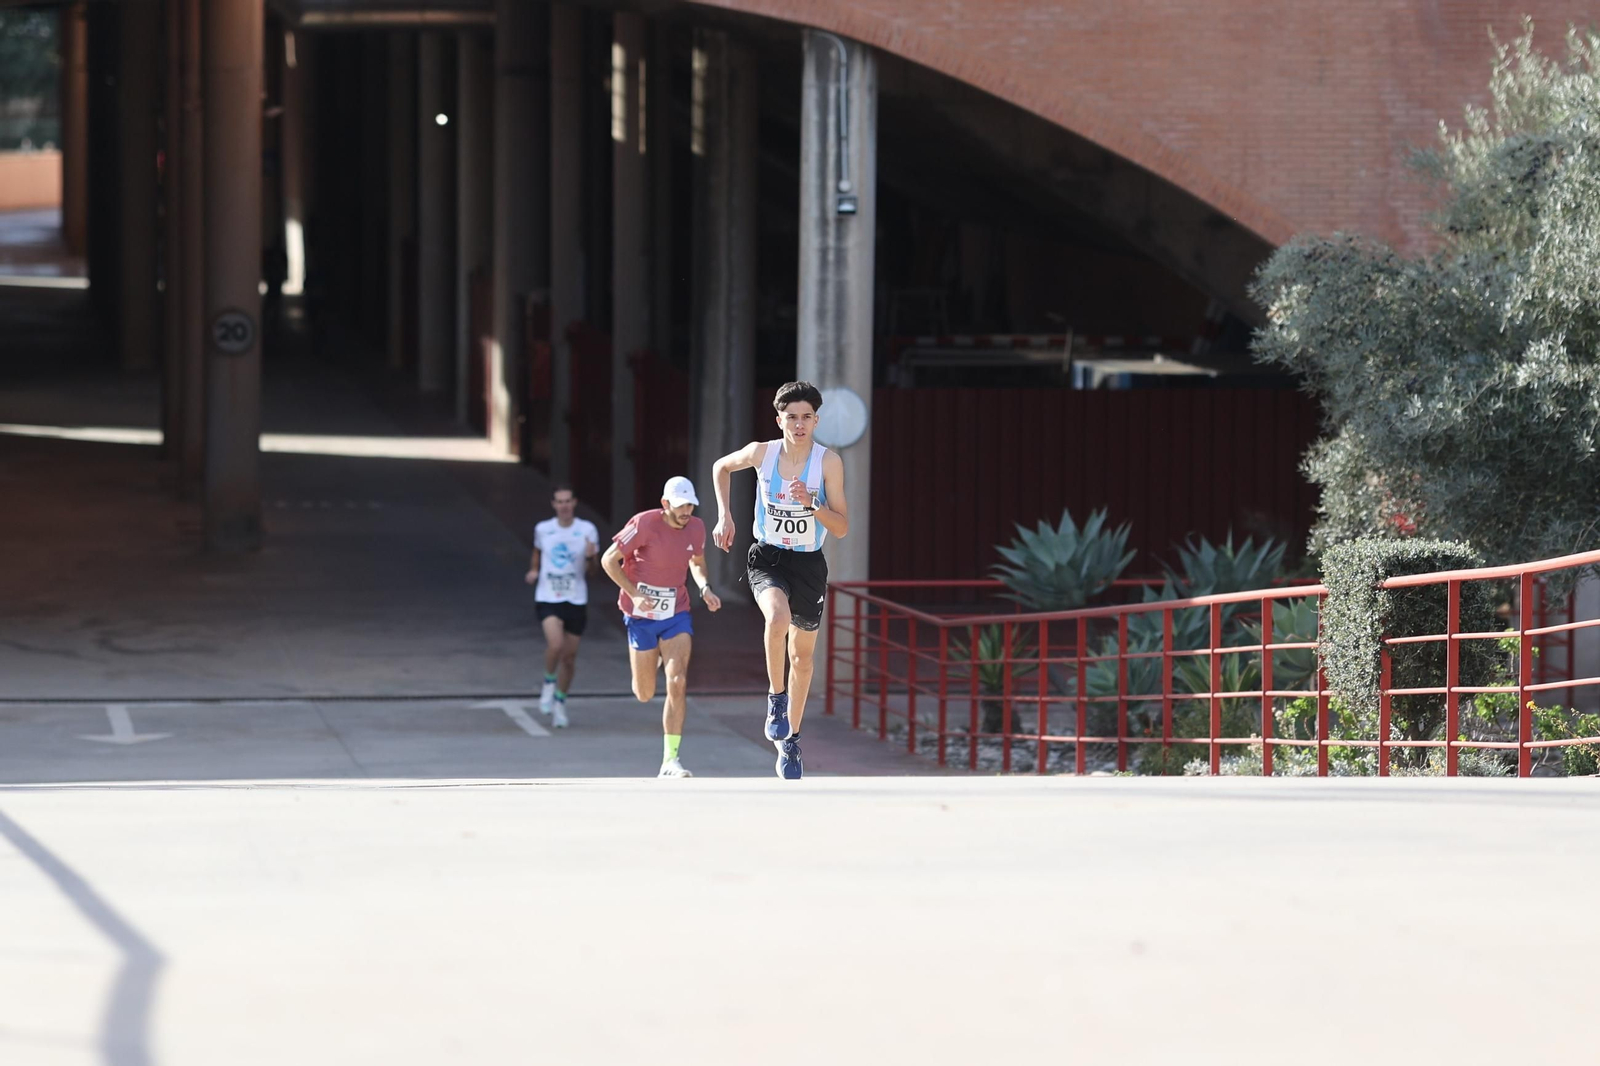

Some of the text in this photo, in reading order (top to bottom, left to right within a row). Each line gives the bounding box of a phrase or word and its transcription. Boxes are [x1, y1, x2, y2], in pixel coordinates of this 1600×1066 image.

[219, 321, 248, 341] 20
[768, 508, 788, 517] UMA
[773, 518, 807, 534] 700
[640, 587, 657, 596] UMA
[650, 598, 669, 611] 76
